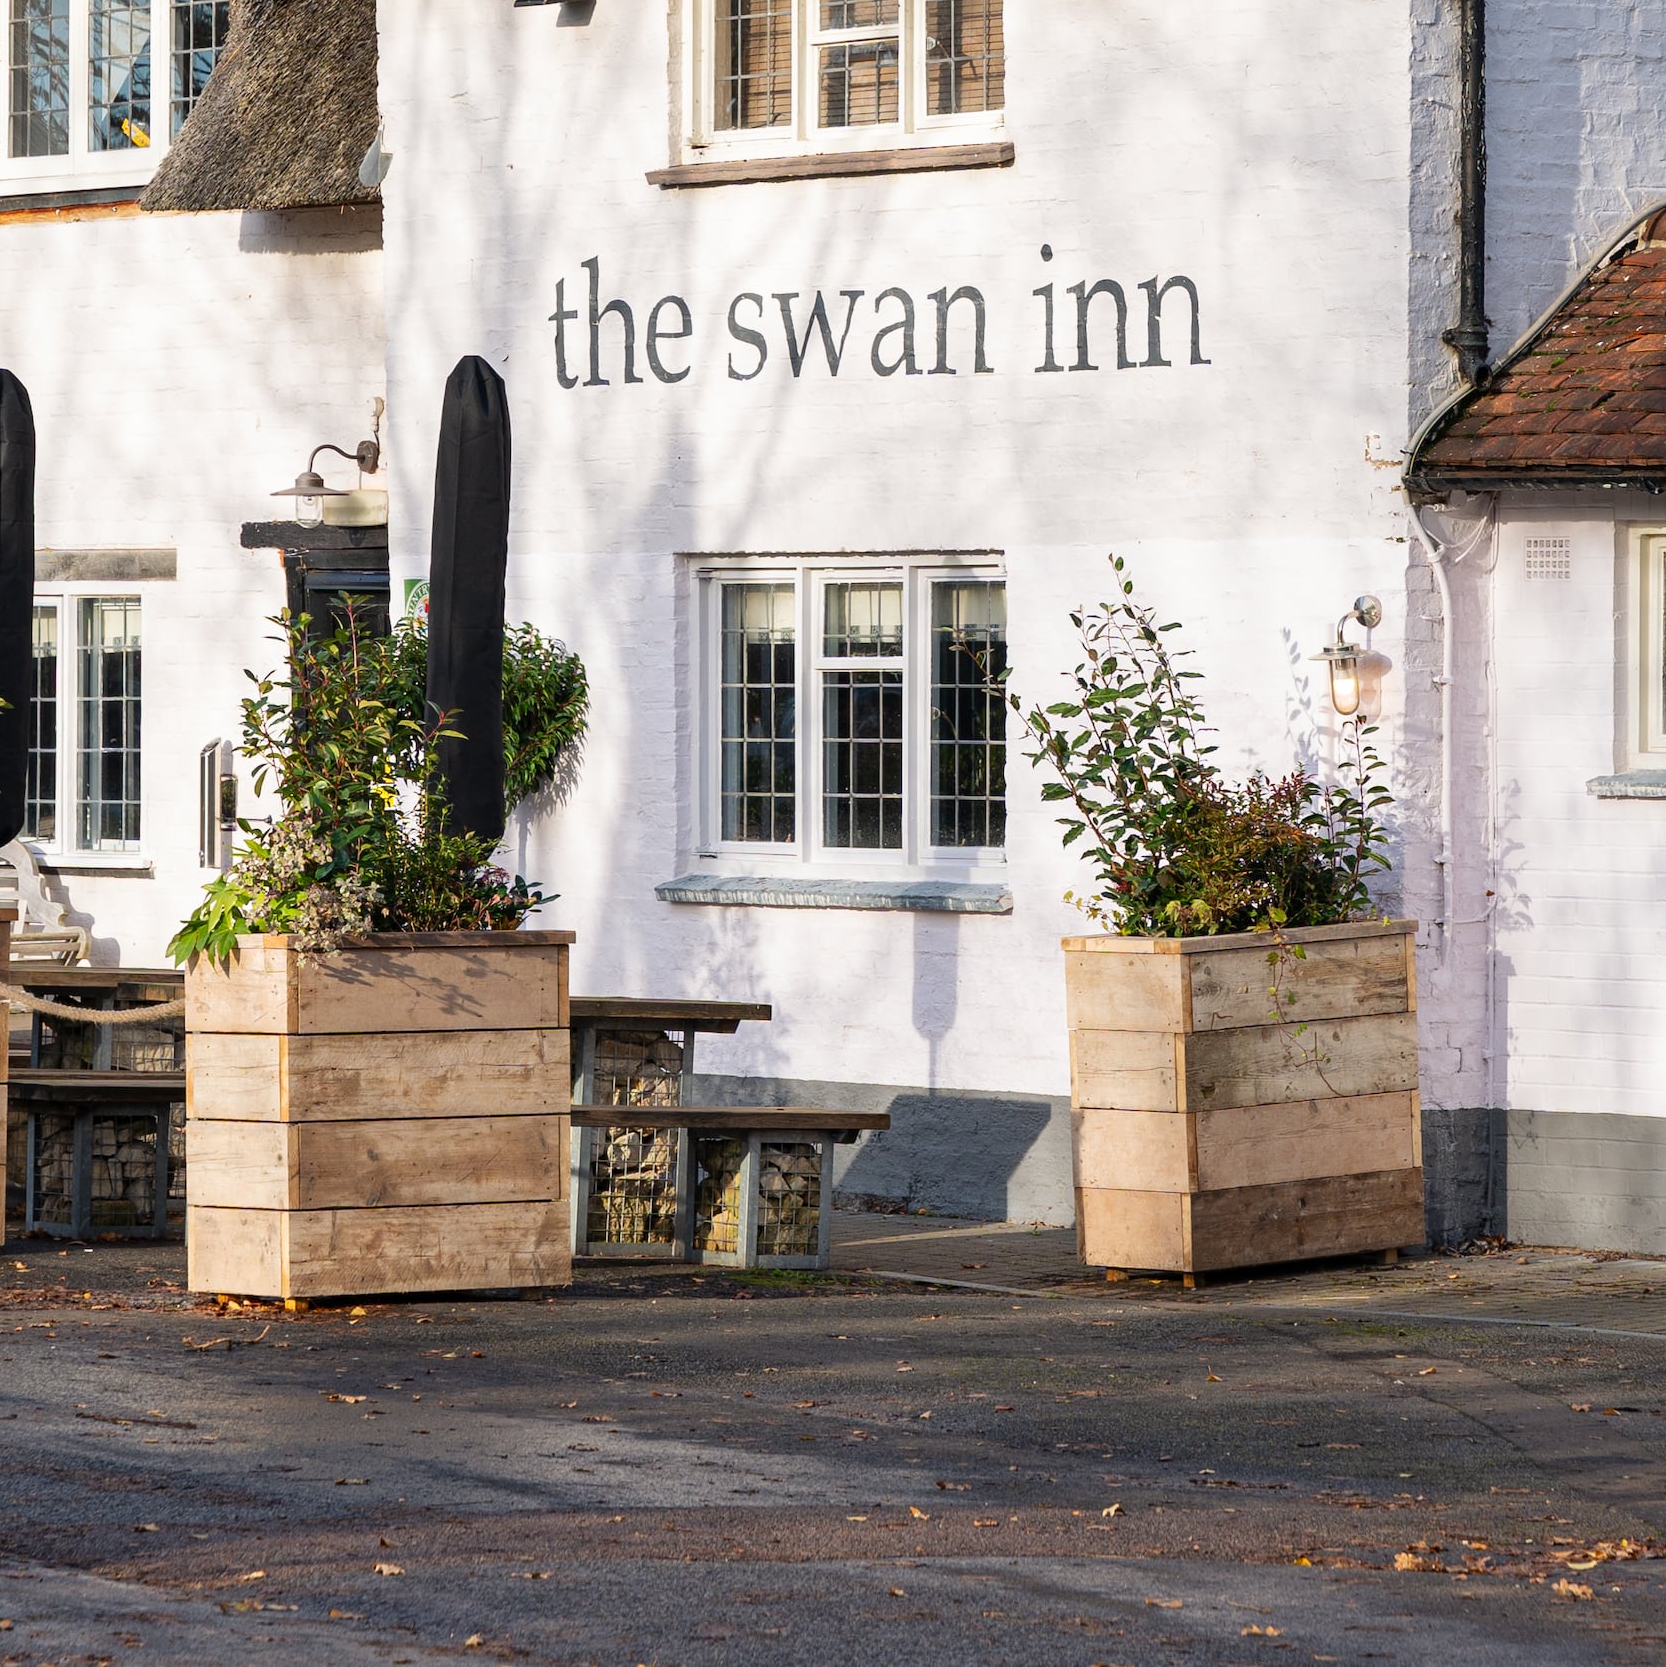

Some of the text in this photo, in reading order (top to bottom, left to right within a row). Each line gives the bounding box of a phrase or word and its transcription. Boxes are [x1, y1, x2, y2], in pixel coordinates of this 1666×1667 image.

[548, 243, 1213, 390] the swan inn
